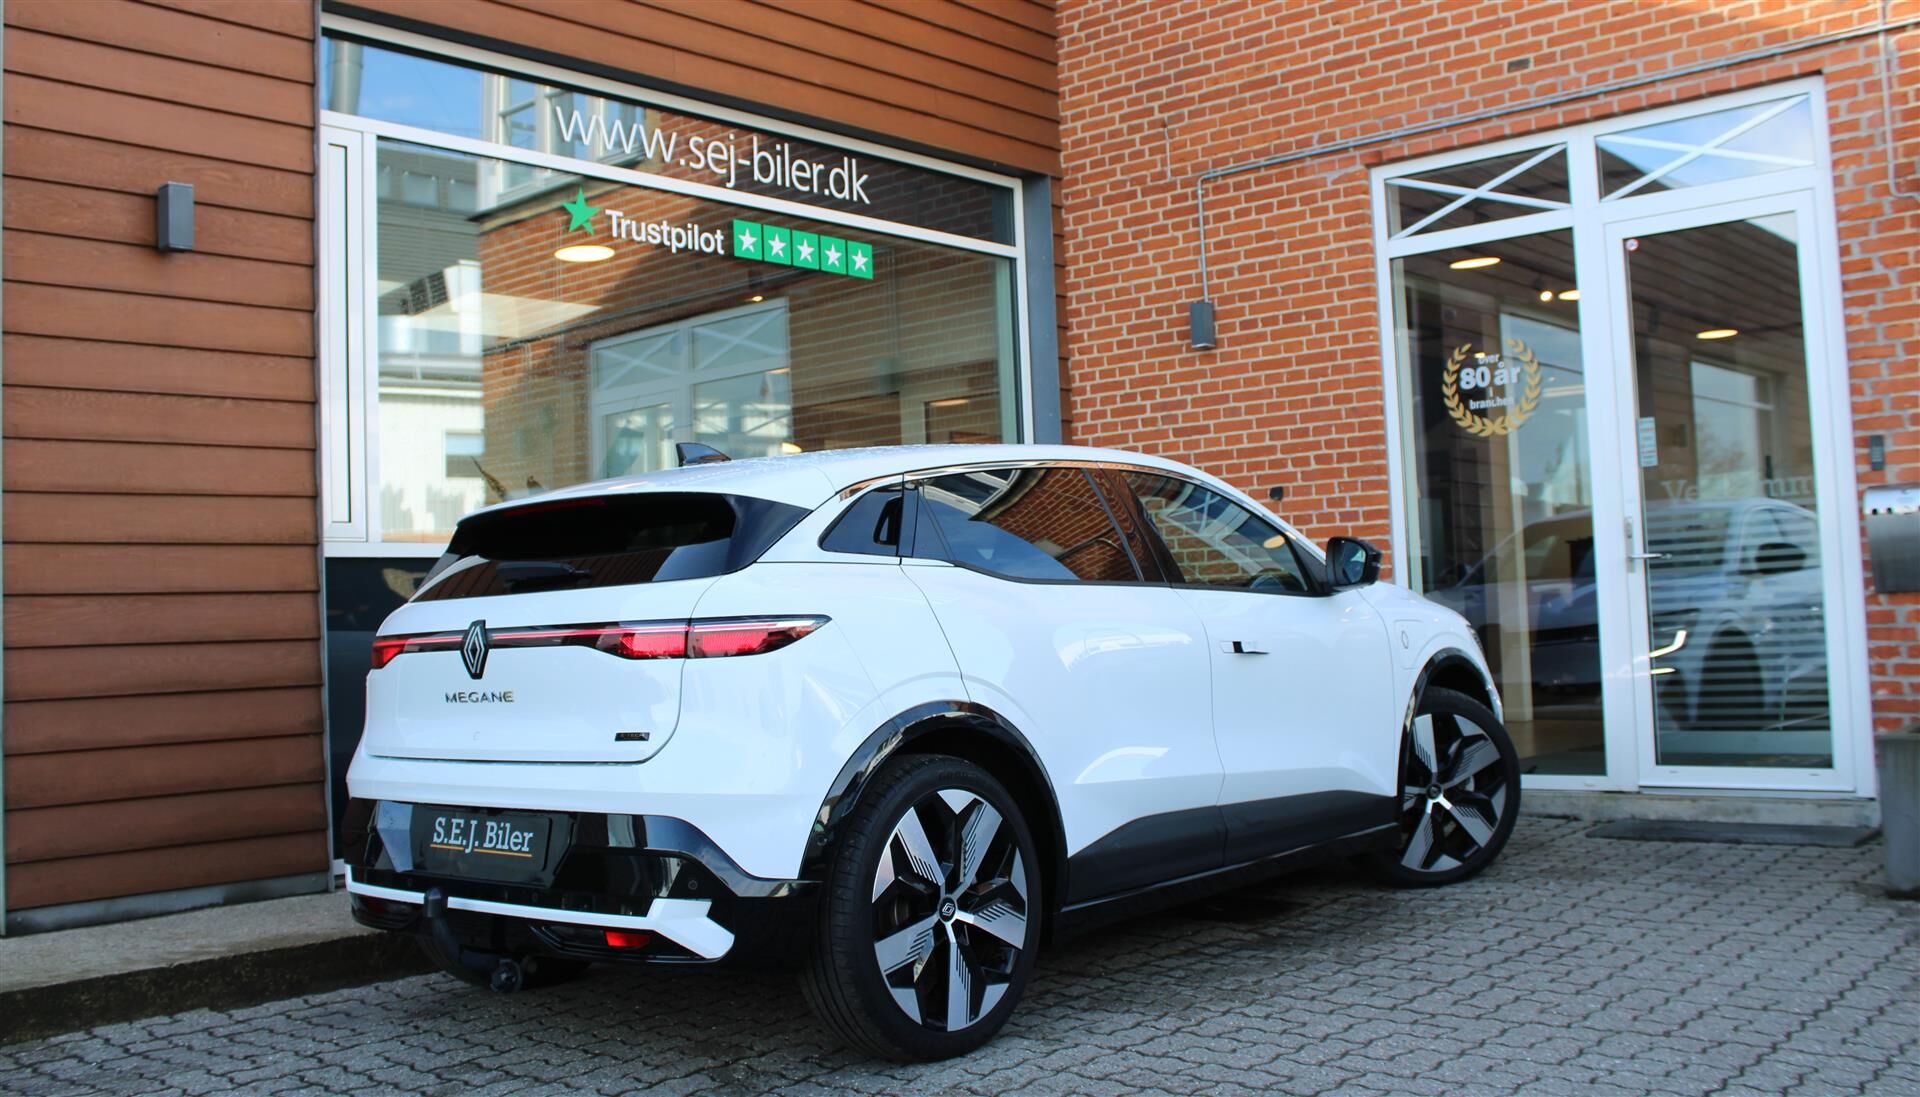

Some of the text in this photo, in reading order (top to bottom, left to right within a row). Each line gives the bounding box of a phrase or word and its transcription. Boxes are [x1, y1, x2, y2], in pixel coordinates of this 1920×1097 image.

[556, 106, 870, 204] www.sej-biler.dk
[605, 208, 725, 255] Trustpilot
[1460, 361, 1520, 390] 80 år
[445, 691, 514, 704] MEGANE
[432, 816, 534, 854] S.E.J. Biler
